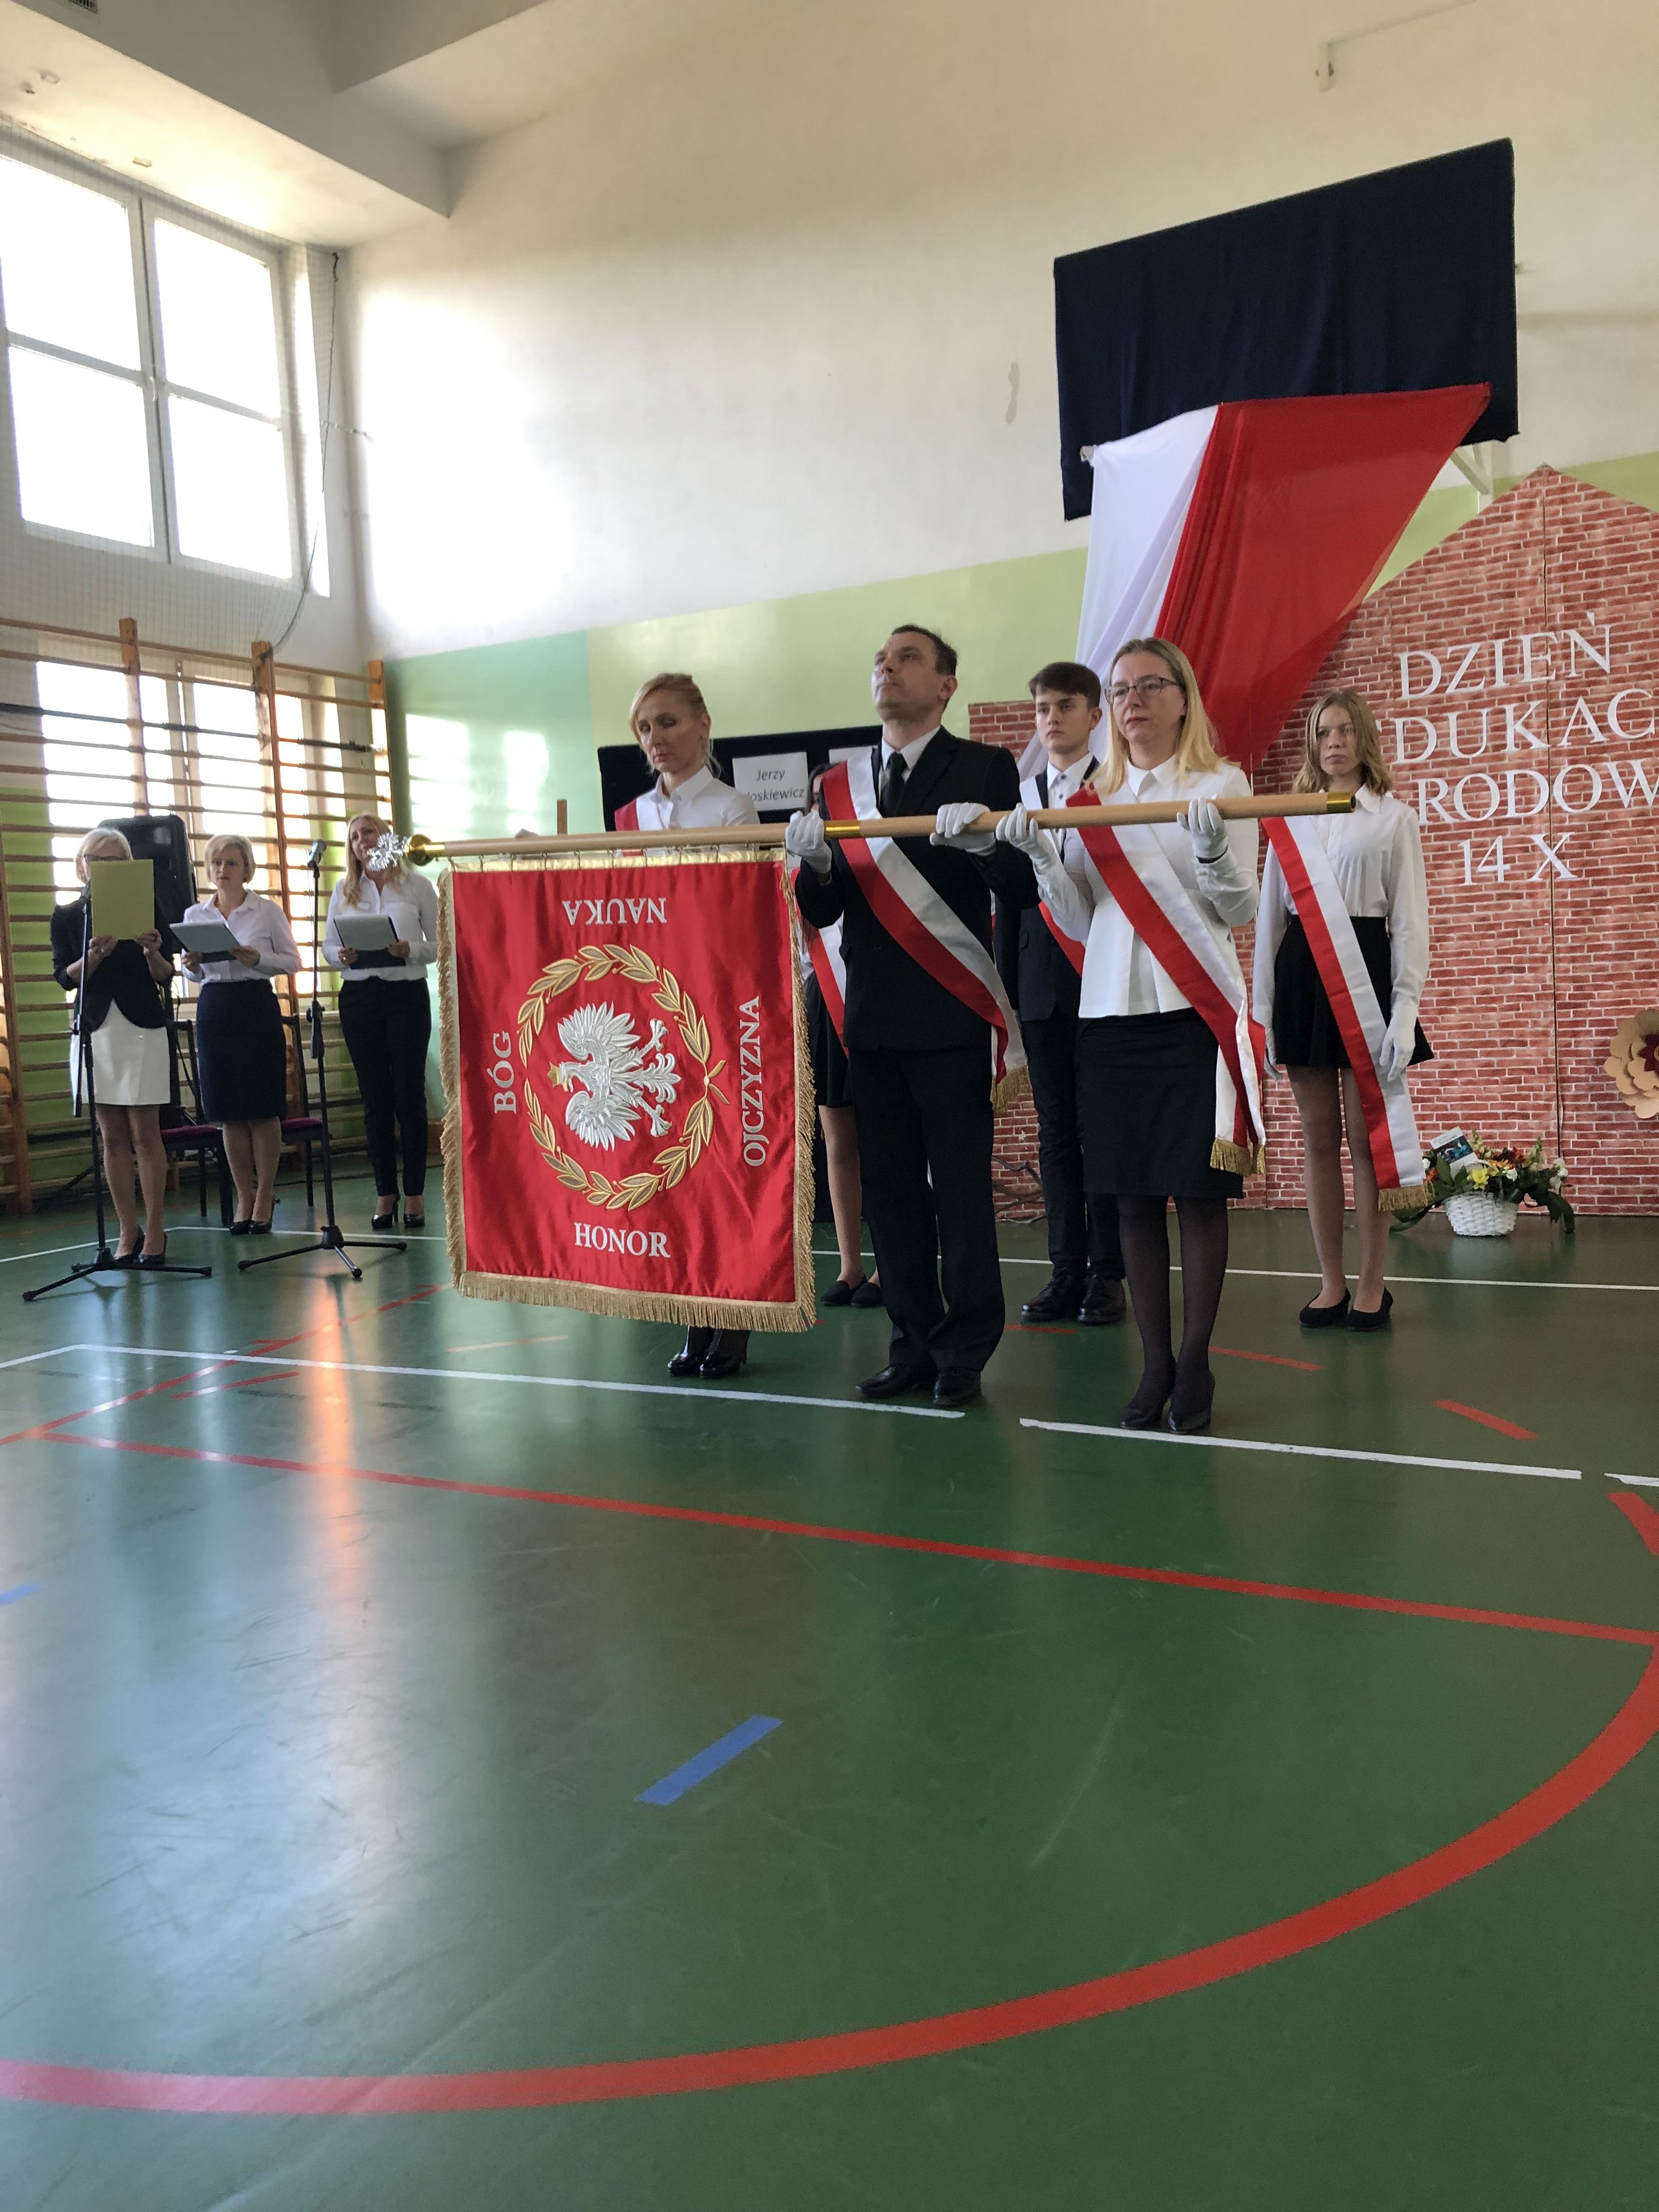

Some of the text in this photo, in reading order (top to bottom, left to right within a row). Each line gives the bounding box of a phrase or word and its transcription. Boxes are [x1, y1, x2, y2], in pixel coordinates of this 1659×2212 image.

[1393, 611, 1613, 701] DZIEŃ
[1375, 689, 1656, 764] DUKAC
[747, 787, 805, 803] oskiewicz
[757, 770, 786, 782] Jerzy
[1386, 759, 1659, 825] RODOW
[1458, 831, 1578, 886] 14 X
[562, 897, 667, 926] NAUKA
[487, 1030, 517, 1114] BÓG
[739, 995, 770, 1167] OJCZYZNA
[573, 1221, 671, 1258] HONOR
